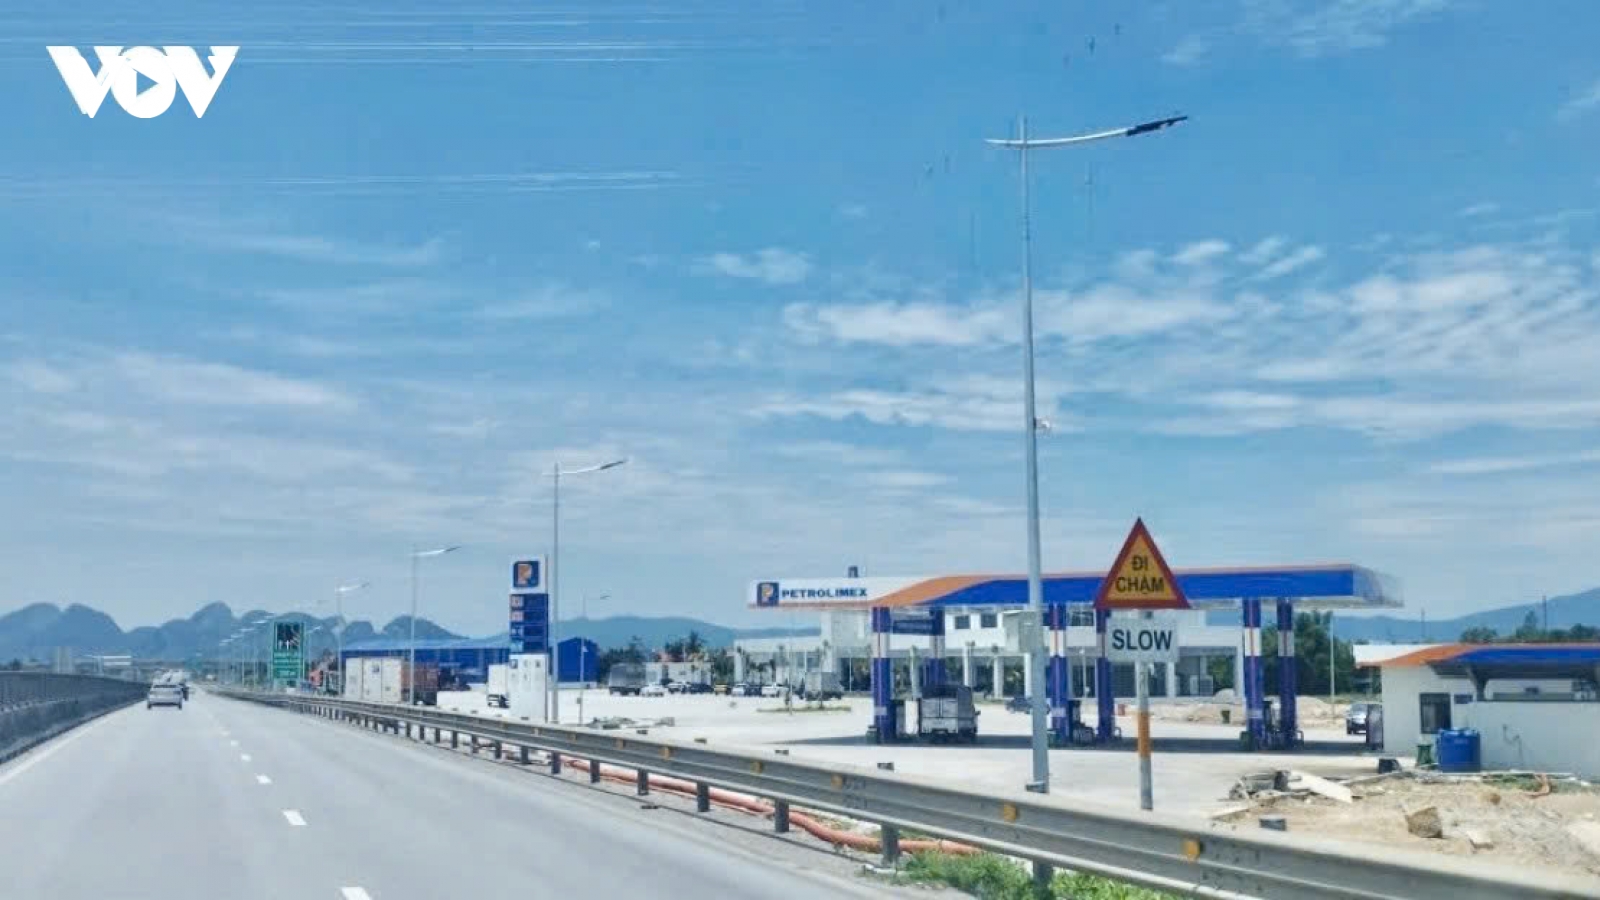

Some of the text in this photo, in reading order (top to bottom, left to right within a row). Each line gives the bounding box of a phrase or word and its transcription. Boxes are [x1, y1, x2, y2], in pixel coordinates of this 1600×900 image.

[1131, 554, 1149, 571] ĐI
[781, 588, 868, 599] PETROLIMEX
[1115, 577, 1165, 595] CHẠM
[1111, 629, 1173, 651] SLOW
